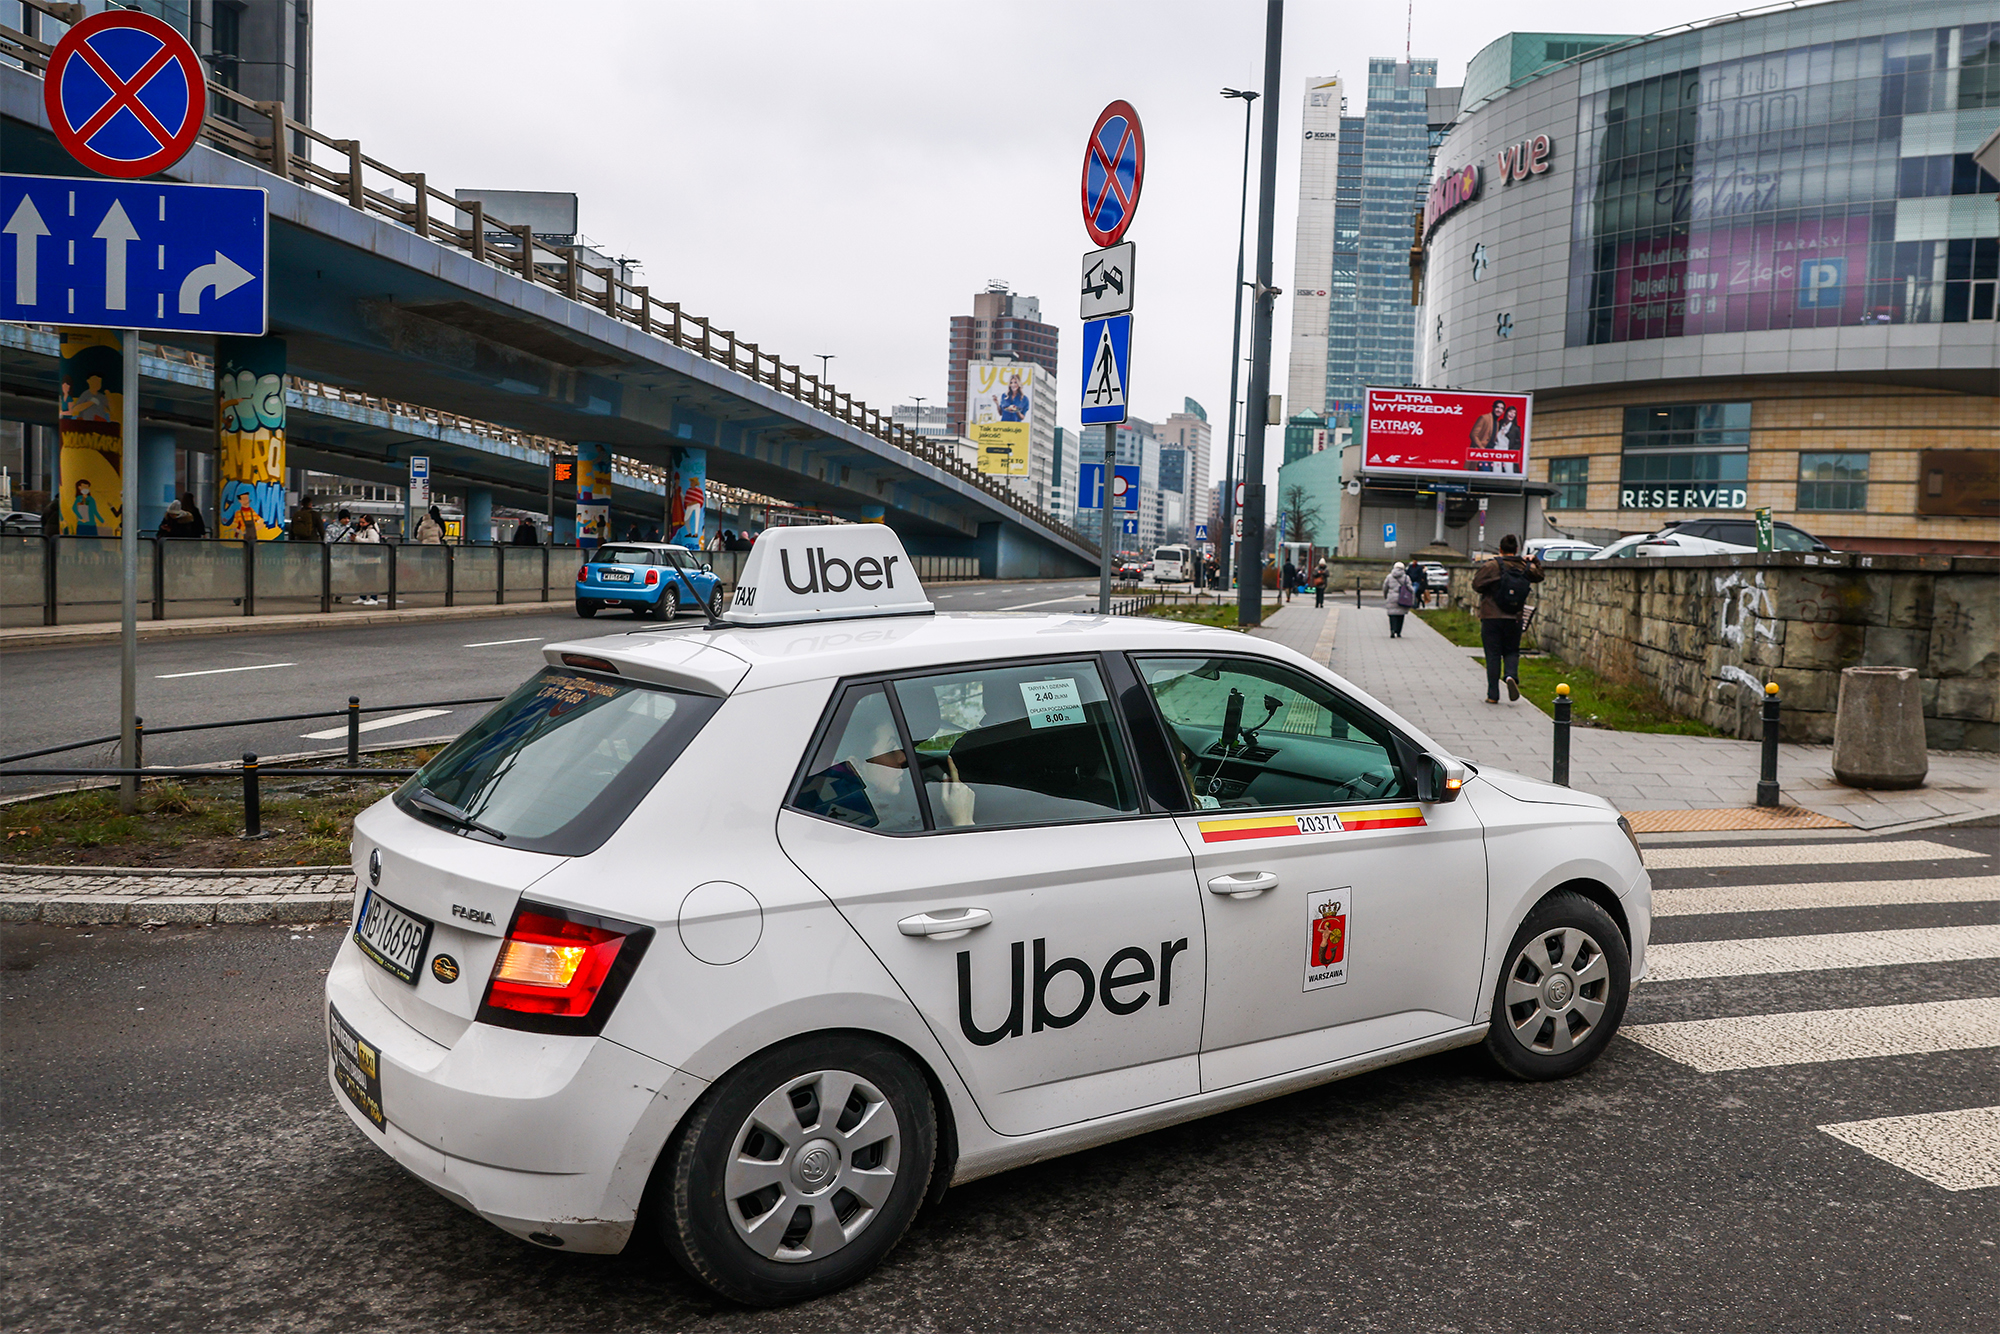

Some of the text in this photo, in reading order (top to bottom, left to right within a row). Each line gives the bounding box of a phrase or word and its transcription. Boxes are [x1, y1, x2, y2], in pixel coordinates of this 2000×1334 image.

[1311, 93, 1332, 107] EY
[1498, 134, 1550, 186] vue
[1372, 393, 1433, 404] ULTRA
[1372, 402, 1463, 415] WYPRZEDAŻ
[1370, 419, 1424, 436] EXTRA%
[1469, 451, 1516, 460] FACTORY
[1622, 489, 1748, 509] RESERVED
[1386, 524, 1394, 537] P
[779, 547, 899, 595] Uber
[734, 586, 758, 607] TAXI
[1035, 691, 1054, 702] 2,40
[1048, 704, 1080, 712] POCZĄTKOWA
[1045, 713, 1064, 723] 8,00
[1297, 814, 1343, 833] 20371
[452, 904, 496, 926] FABIA
[1308, 969, 1343, 983] WARSZAWA
[956, 937, 1188, 1047] Uber
[360, 1047, 374, 1072] TAXI
